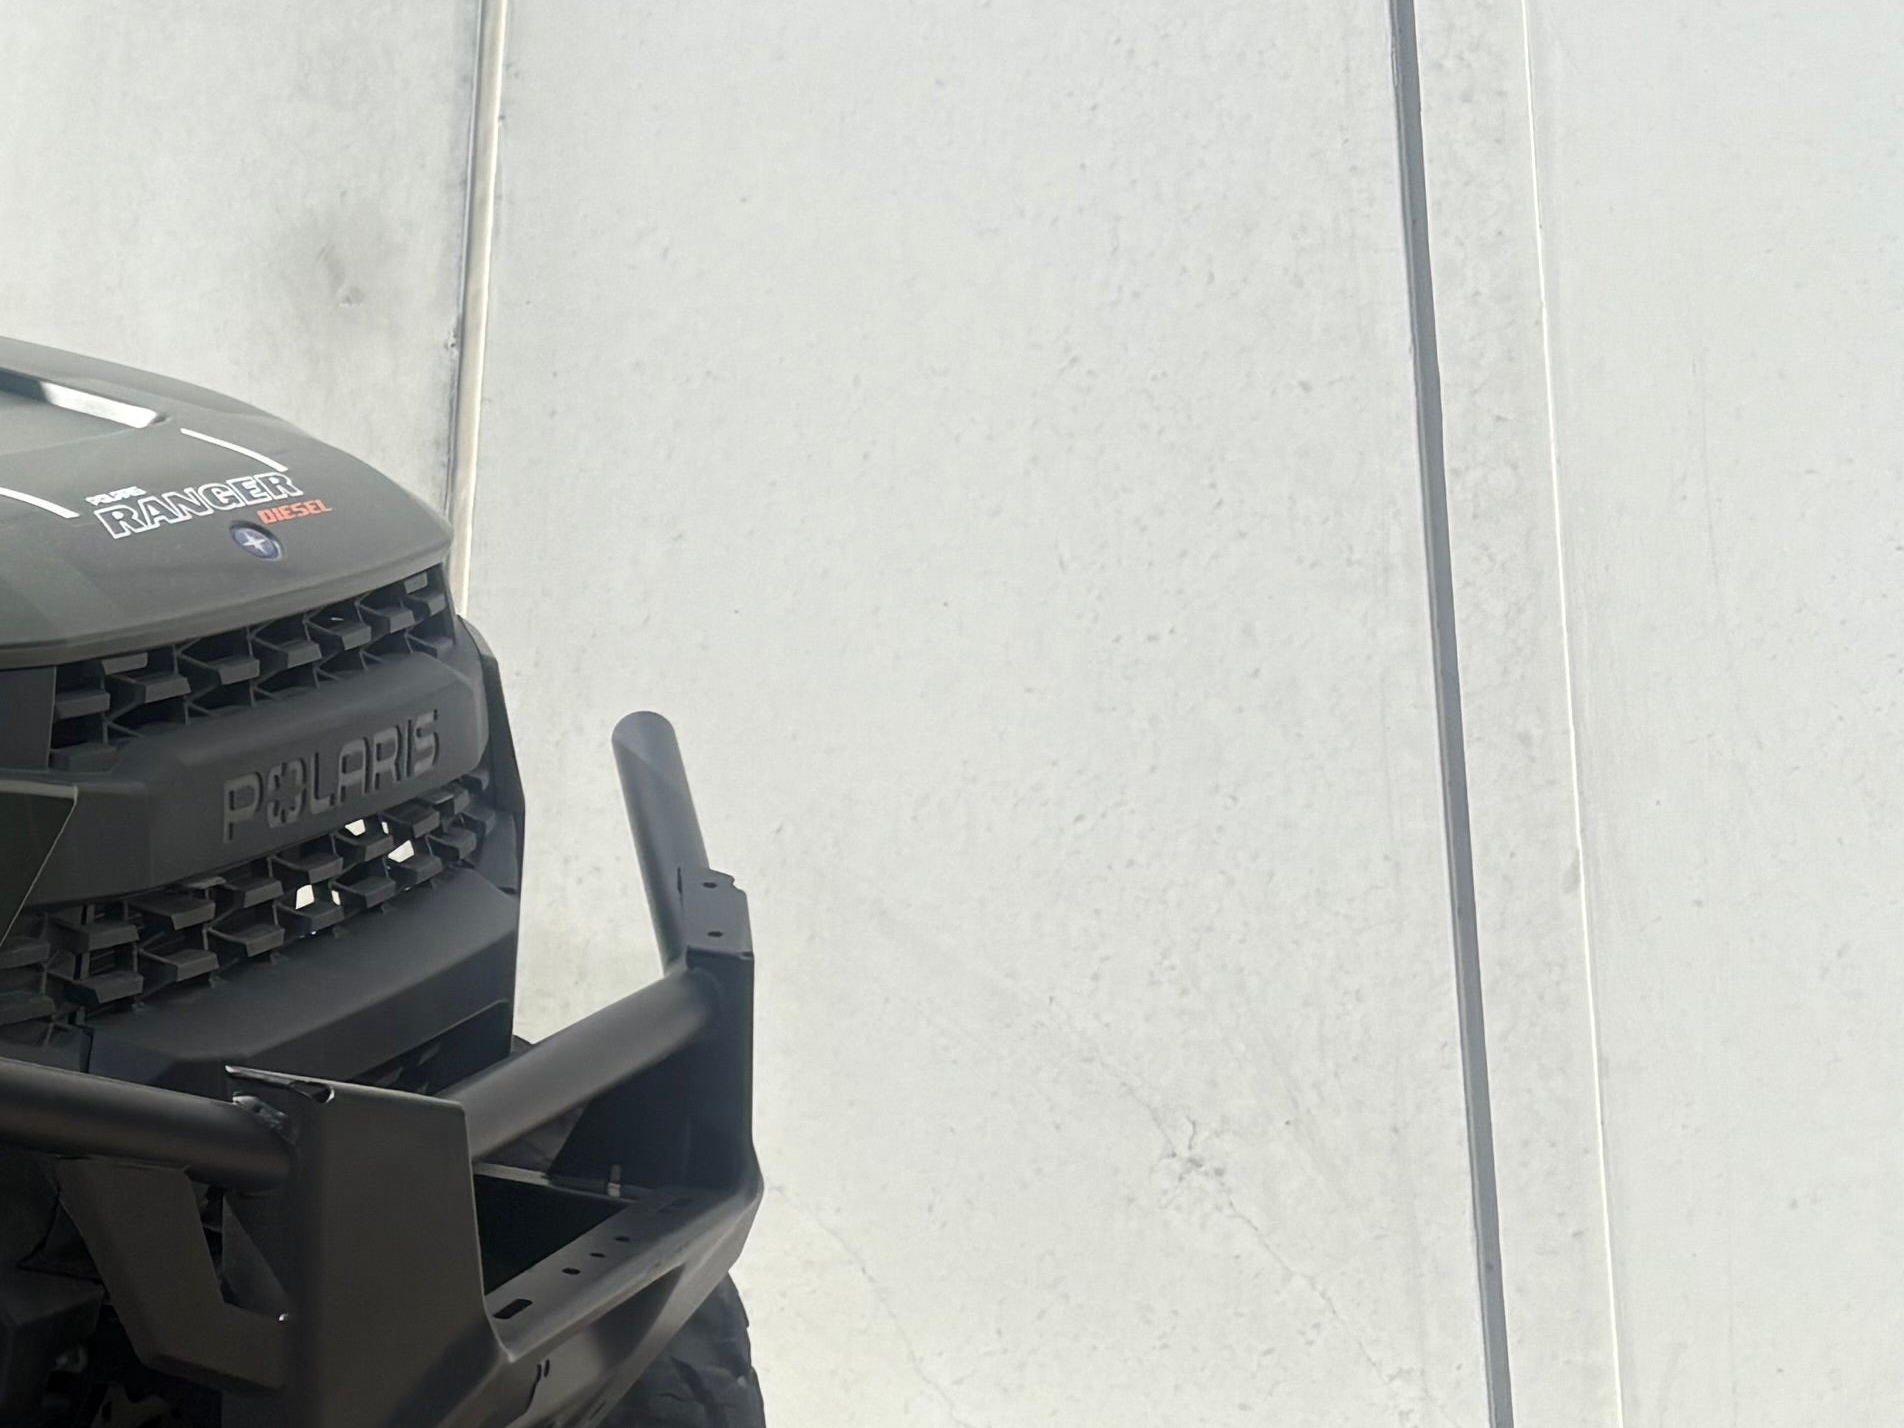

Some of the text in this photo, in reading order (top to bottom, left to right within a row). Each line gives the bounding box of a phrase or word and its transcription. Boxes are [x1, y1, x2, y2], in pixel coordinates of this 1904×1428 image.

[93, 470, 305, 539] RANGER
[255, 499, 333, 525] DIESEL
[222, 708, 441, 845] POLARIS
